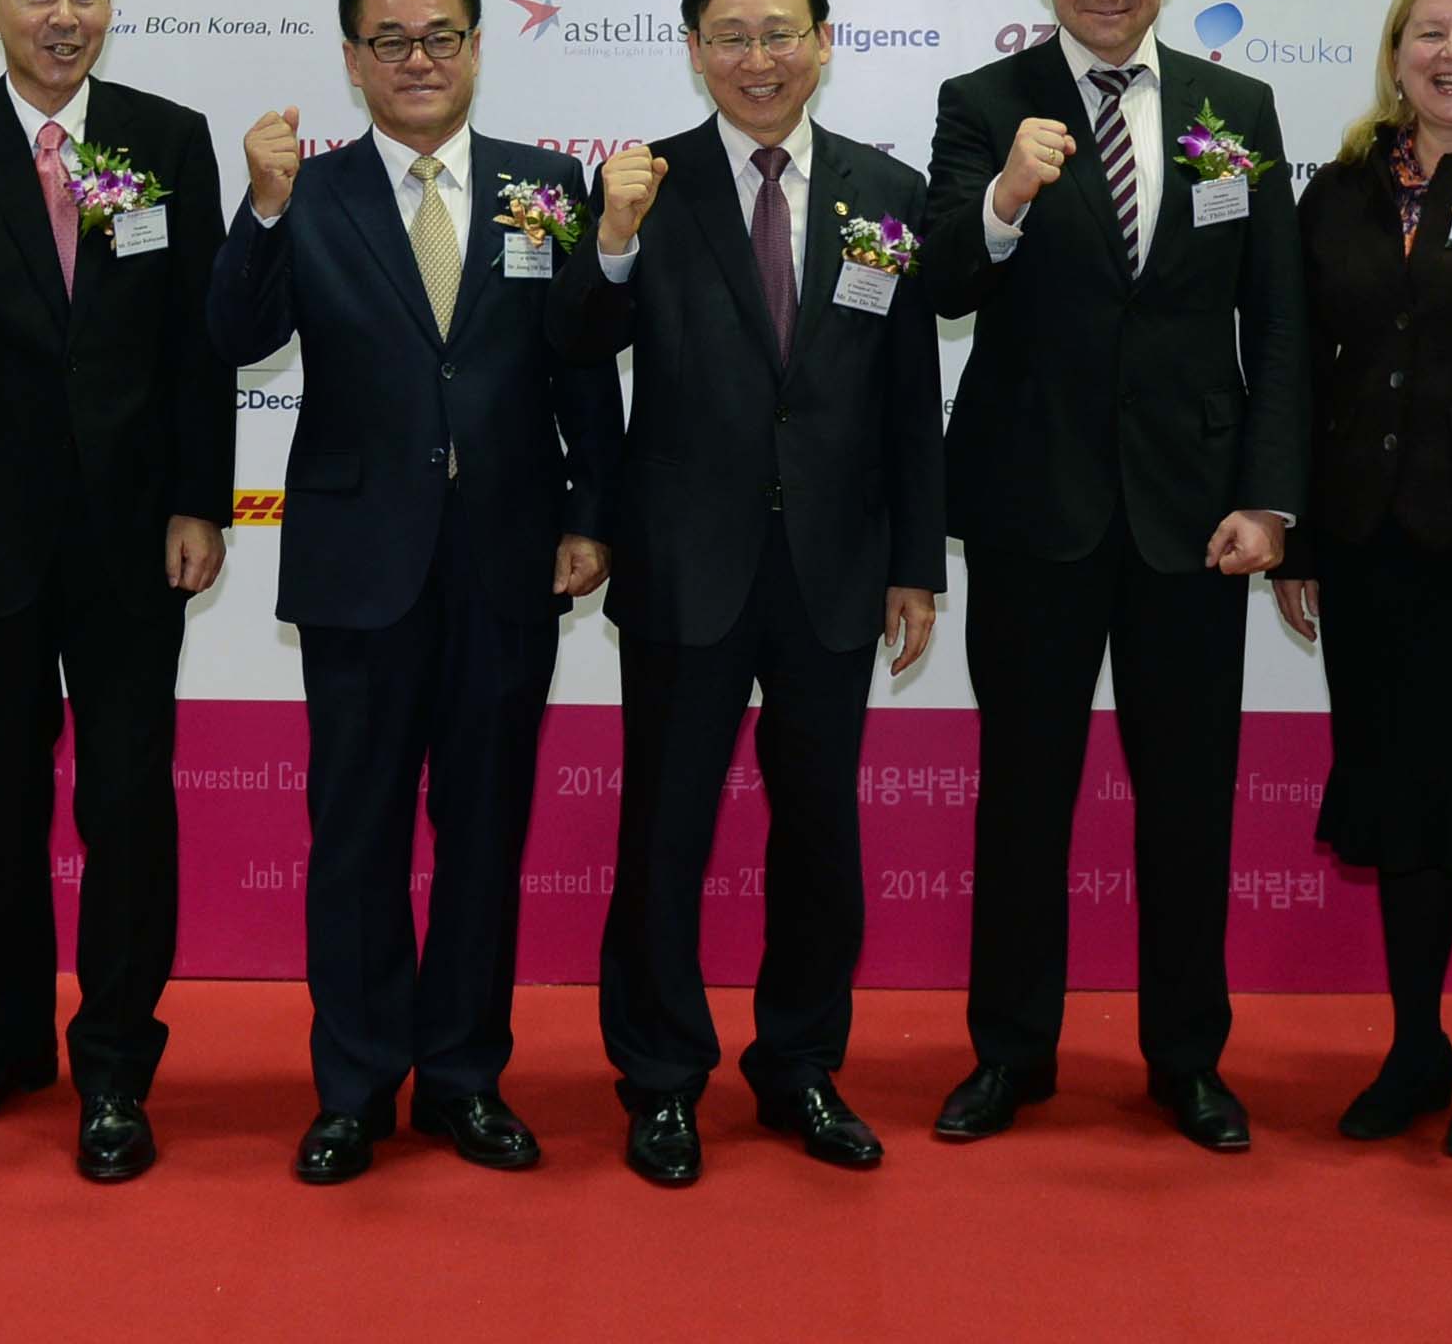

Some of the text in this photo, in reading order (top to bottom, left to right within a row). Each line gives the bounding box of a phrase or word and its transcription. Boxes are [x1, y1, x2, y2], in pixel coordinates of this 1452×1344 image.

[145, 16, 314, 36] BCon Korea, Inc.
[564, 13, 689, 44] astellas
[1244, 37, 1353, 64] Otsuka
[557, 766, 623, 798] 2014
[881, 870, 949, 900] 2014
